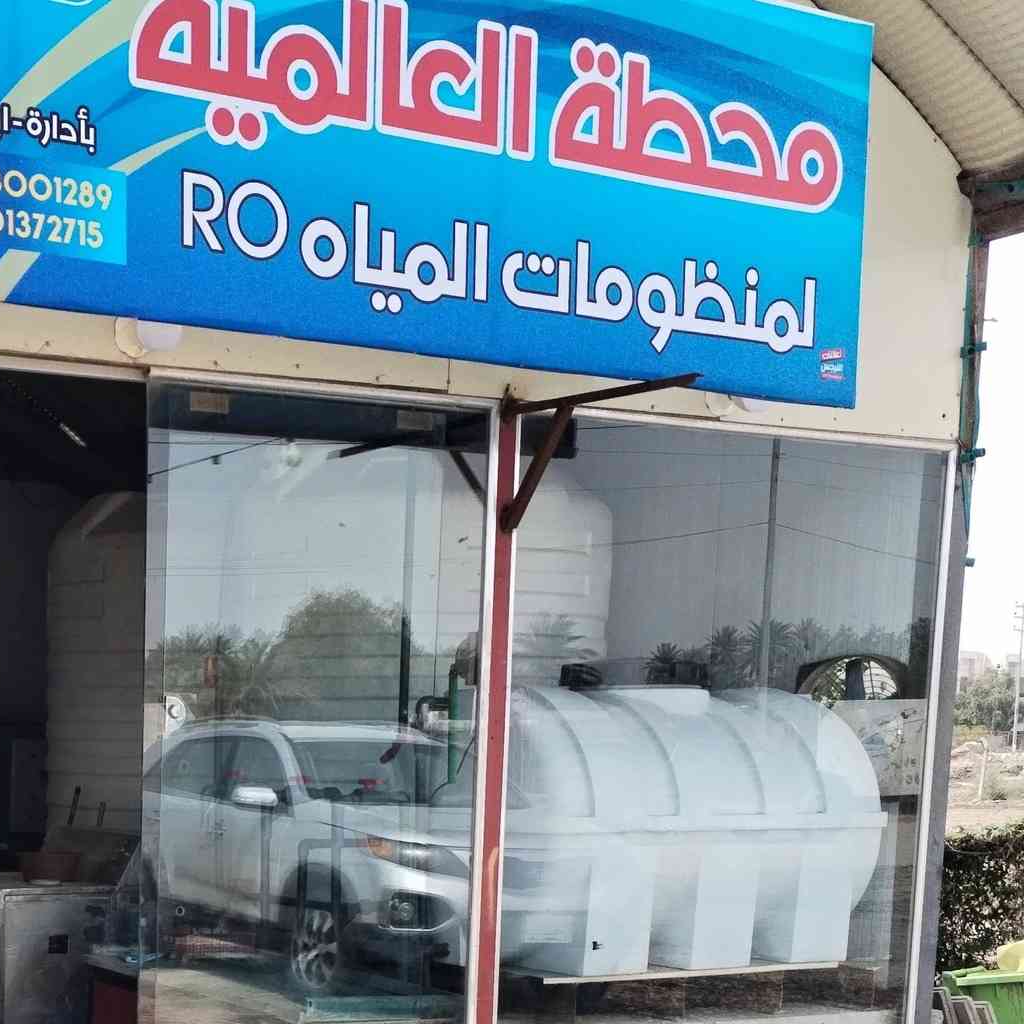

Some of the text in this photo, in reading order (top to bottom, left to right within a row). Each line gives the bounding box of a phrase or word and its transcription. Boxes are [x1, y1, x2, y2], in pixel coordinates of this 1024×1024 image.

[548, 40, 844, 214] محطة
[181, 168, 817, 354] لمنظومات المياه RO
